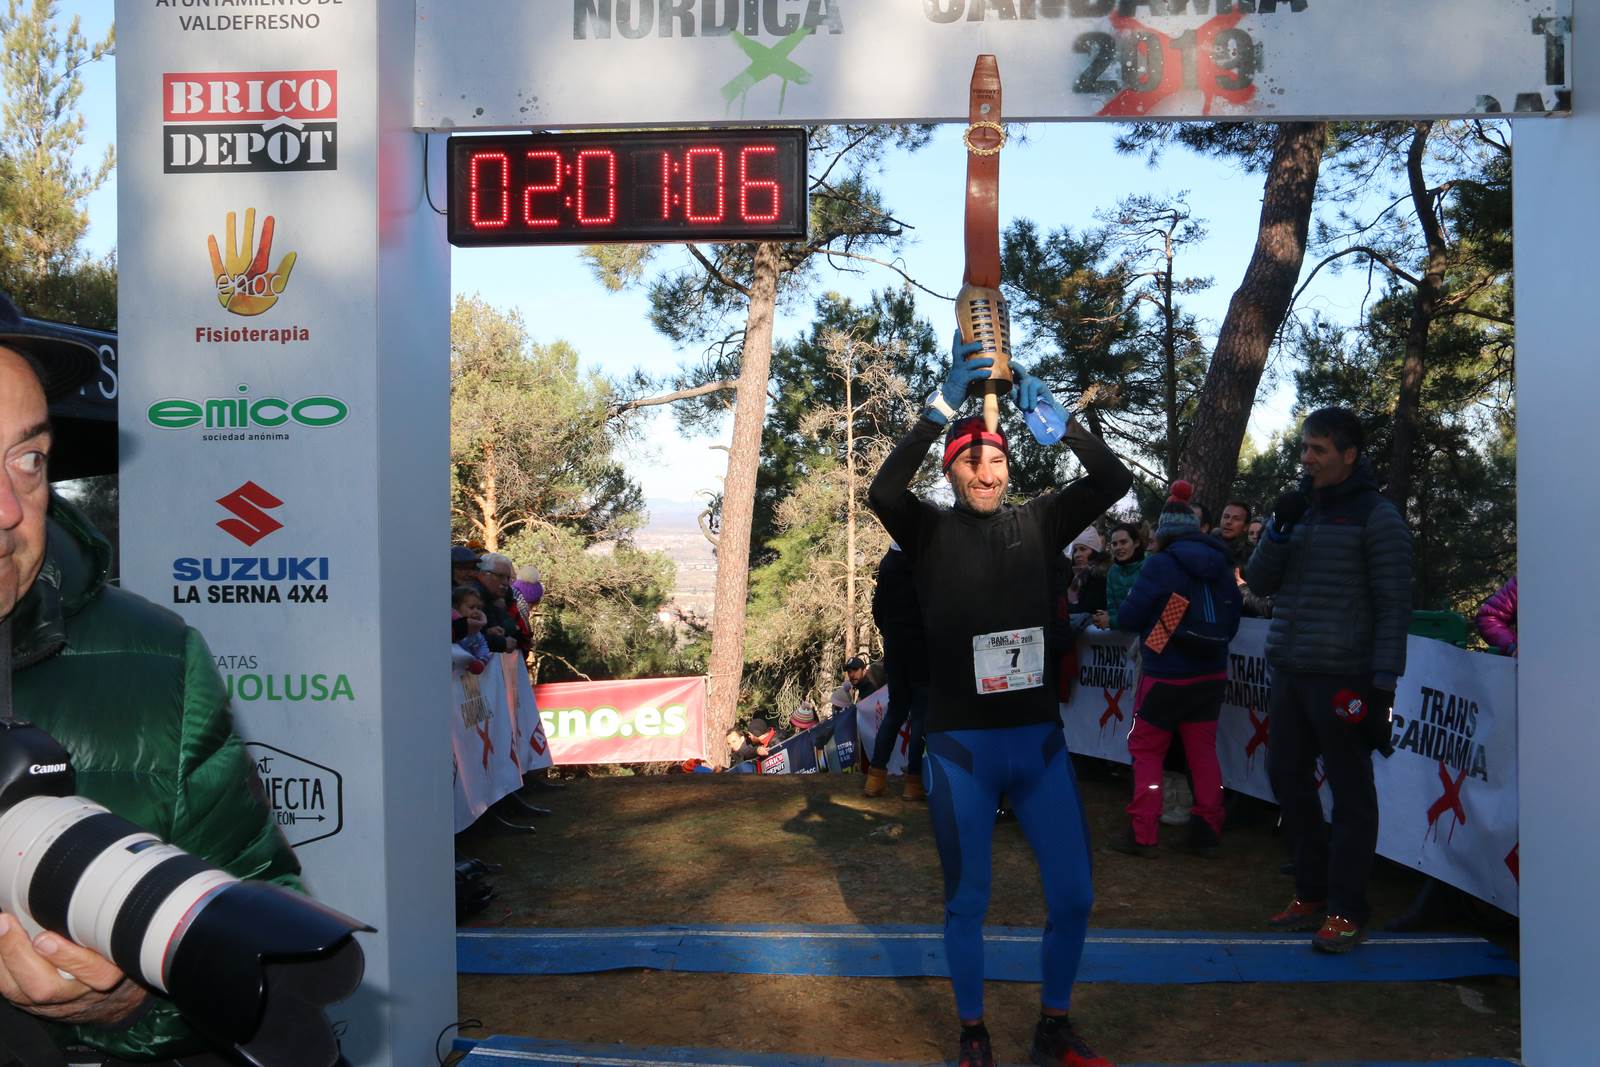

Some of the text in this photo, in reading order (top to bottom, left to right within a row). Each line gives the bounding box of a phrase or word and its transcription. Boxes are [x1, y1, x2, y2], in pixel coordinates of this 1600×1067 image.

[179, 13, 320, 31] VALDEFRESNO
[1072, 27, 1262, 93] 2019
[170, 78, 332, 114] BRICO
[195, 325, 310, 344] Fisioterapia
[147, 384, 349, 430] emico
[202, 431, 290, 441] sociedad anónima
[172, 557, 329, 581] SUZUKI
[173, 584, 328, 603] LA SERNA 4X4
[210, 655, 258, 670] ATAS
[1006, 648, 1021, 668] 7
[1091, 644, 1128, 668] TRANS
[1080, 665, 1134, 690] CANDAMIA
[1420, 686, 1479, 738] TRANS
[1390, 713, 1489, 783] CANDAMIA
[29, 763, 67, 775] Canon
